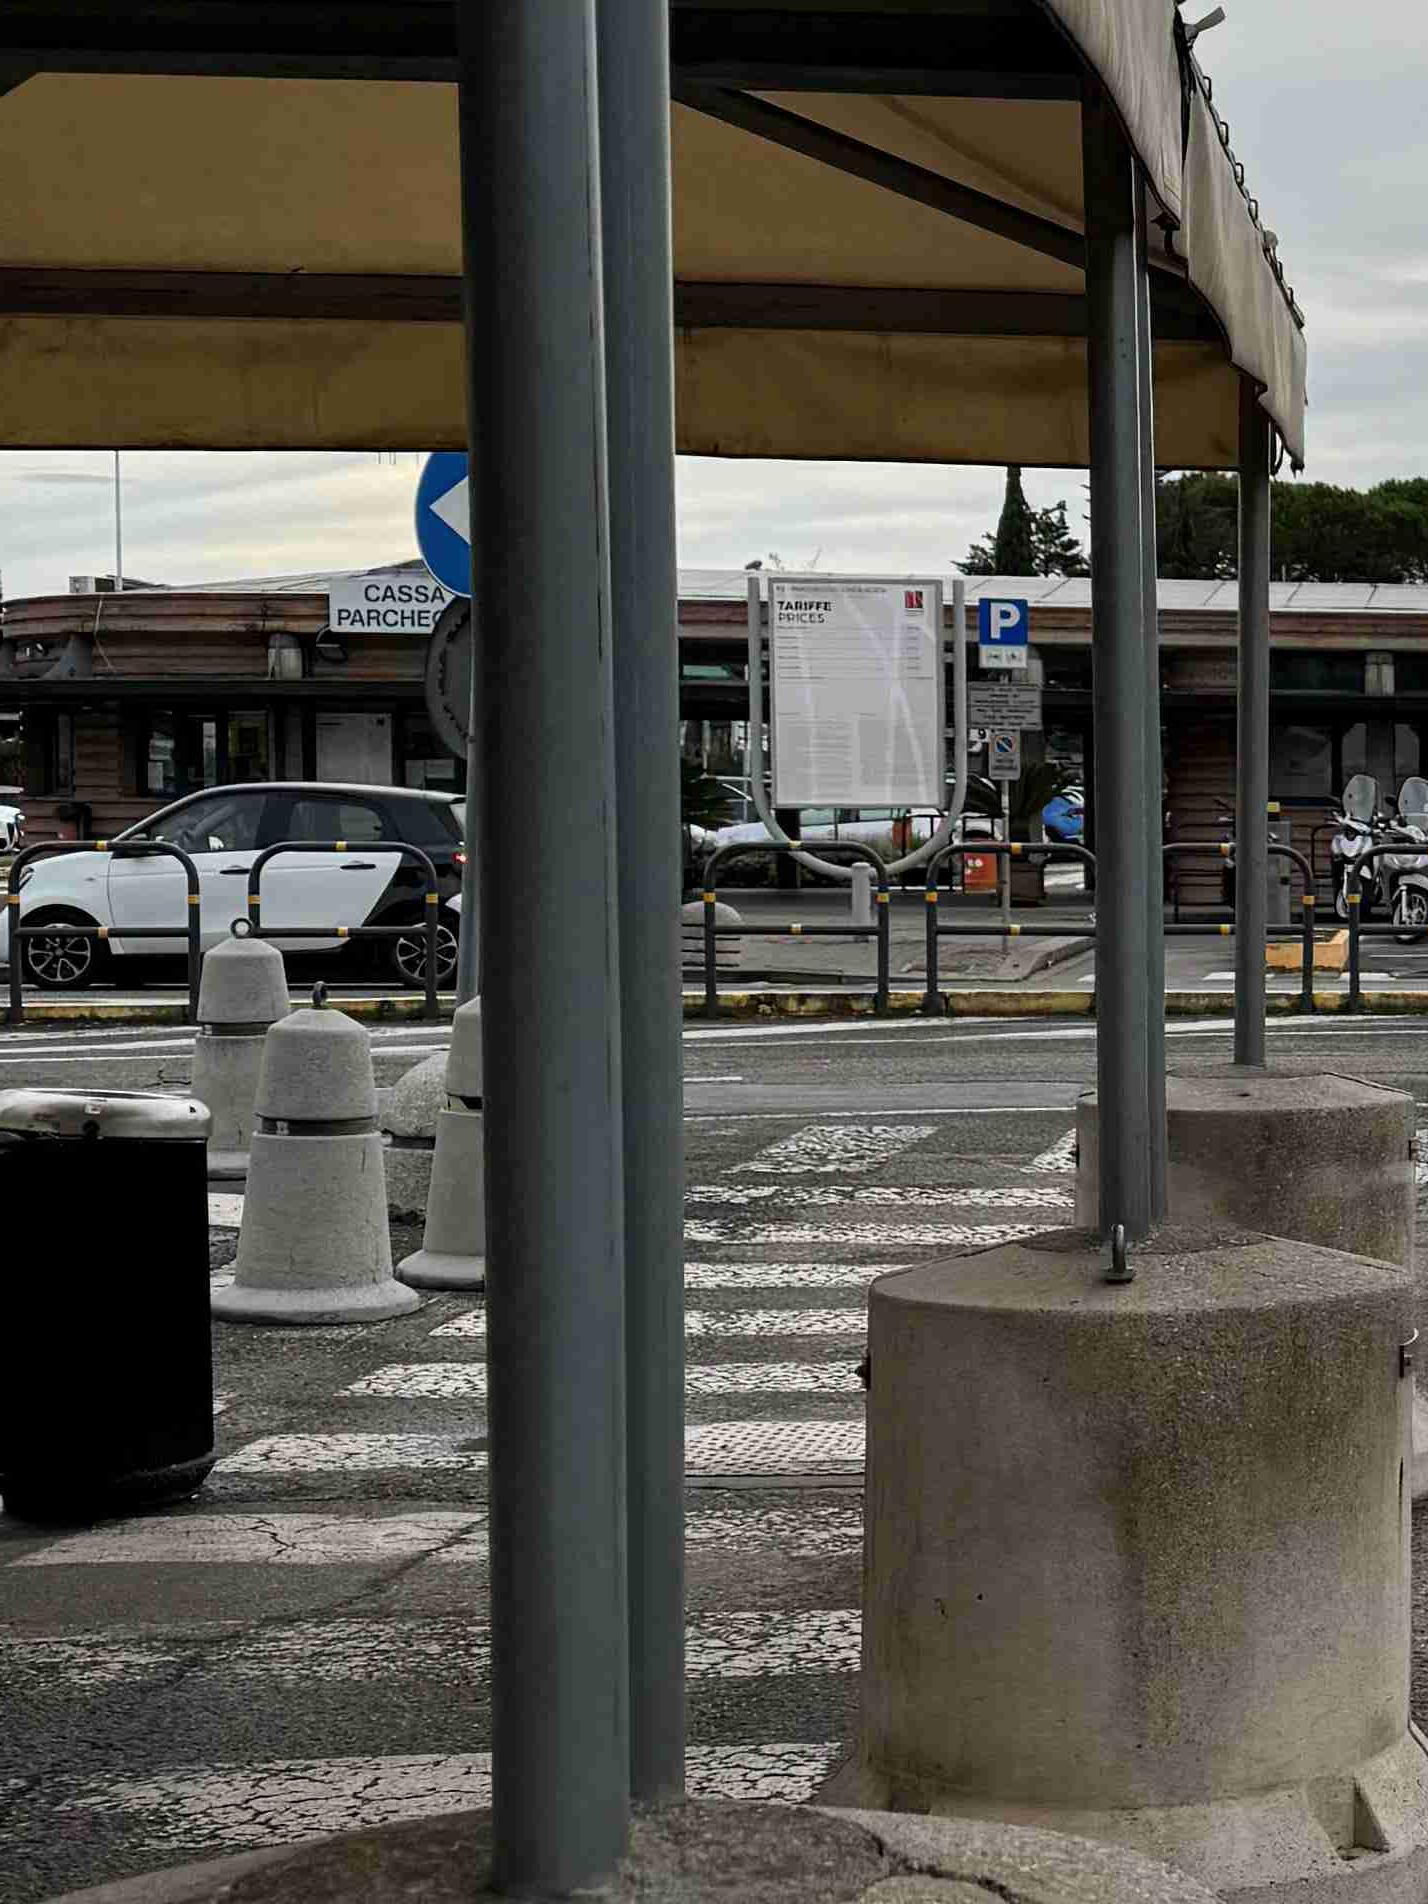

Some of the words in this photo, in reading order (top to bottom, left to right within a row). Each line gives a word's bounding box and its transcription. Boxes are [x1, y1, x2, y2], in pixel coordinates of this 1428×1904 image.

[364, 584, 446, 603] CASSA
[777, 600, 832, 612] TARIFFE
[778, 612, 825, 624] PRICES
[990, 602, 1021, 640] P
